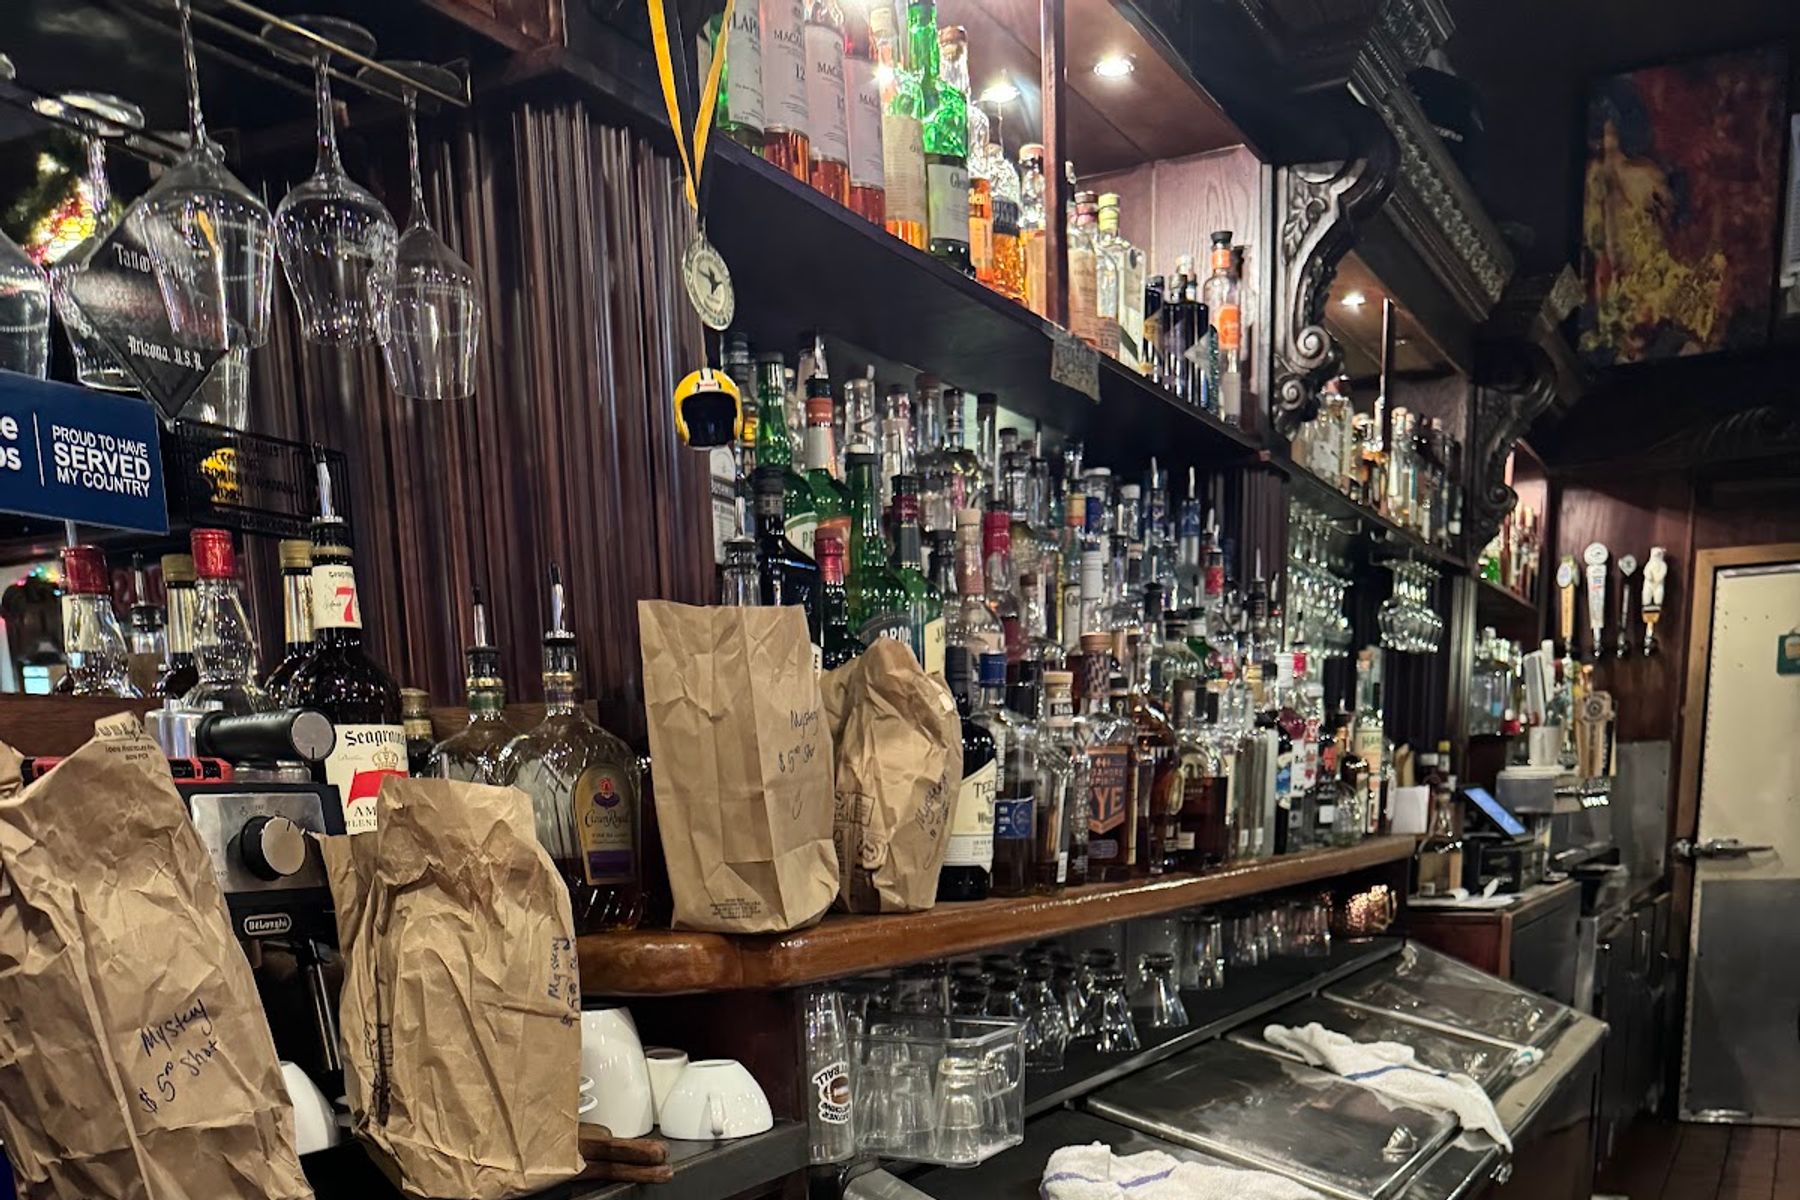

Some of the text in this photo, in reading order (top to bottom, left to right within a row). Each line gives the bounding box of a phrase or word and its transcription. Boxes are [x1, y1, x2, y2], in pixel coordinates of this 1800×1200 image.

[52, 424, 149, 459] PROUD TO HAVE
[53, 441, 151, 481] SERVED
[56, 466, 150, 498] MY COUNTRY
[335, 586, 355, 623] 7
[140, 998, 213, 1058] Mystery
